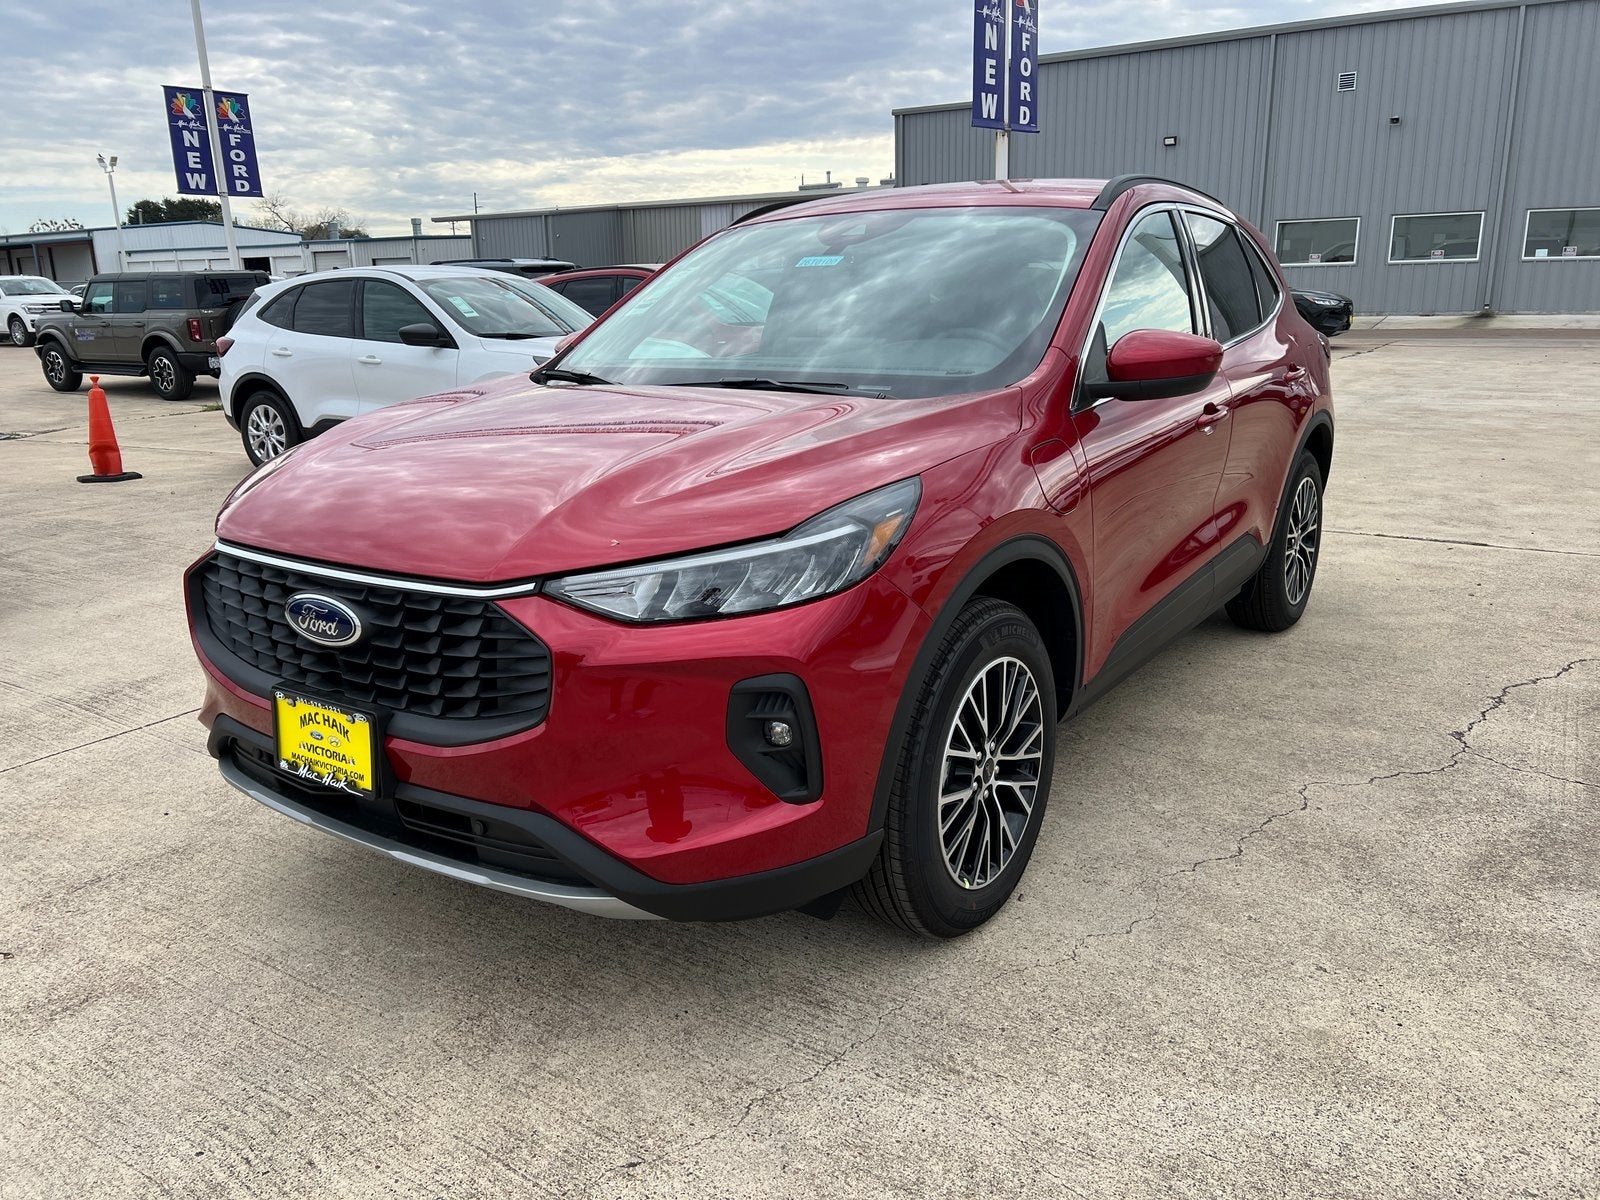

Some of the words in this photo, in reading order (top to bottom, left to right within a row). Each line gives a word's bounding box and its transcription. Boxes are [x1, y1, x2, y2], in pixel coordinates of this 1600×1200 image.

[981, 22, 998, 120] NEW
[1019, 32, 1032, 125] FORD
[182, 130, 206, 190] NEW
[228, 133, 250, 192] FORD
[298, 604, 339, 636] Ford
[300, 712, 321, 729] MAC
[322, 713, 351, 743] HAIK
[305, 742, 348, 765] VICTORIA
[297, 764, 319, 781] Mac
[321, 772, 352, 790] Haik
